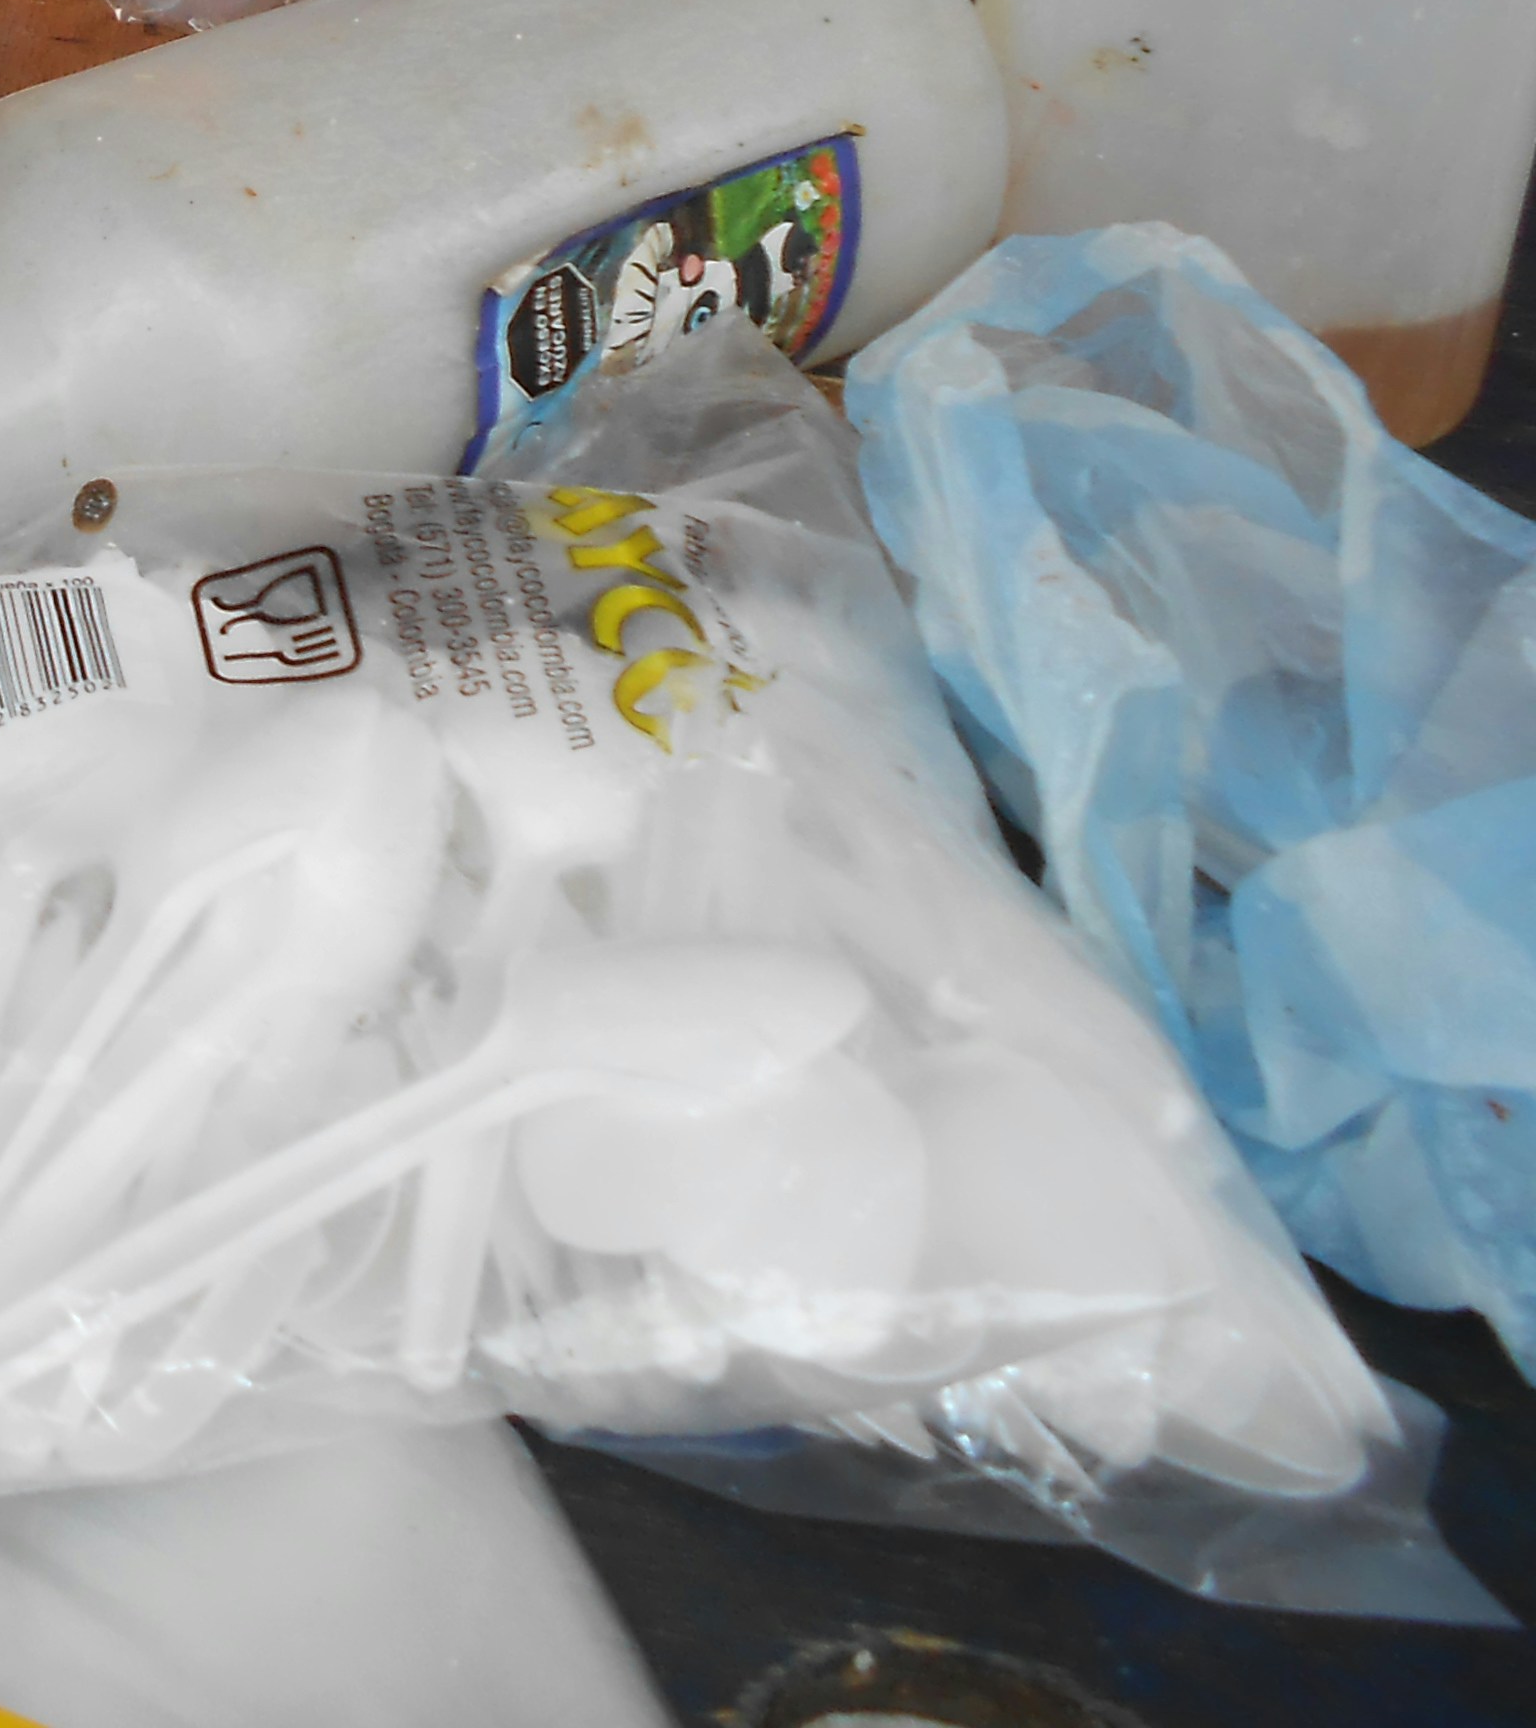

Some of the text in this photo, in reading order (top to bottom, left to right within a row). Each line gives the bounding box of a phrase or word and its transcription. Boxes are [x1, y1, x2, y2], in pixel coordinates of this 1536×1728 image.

[534, 313, 551, 387] EXCESO
[62, 575, 95, 588] 100
[388, 588, 443, 701] Colombia
[431, 587, 492, 697] 300-3545
